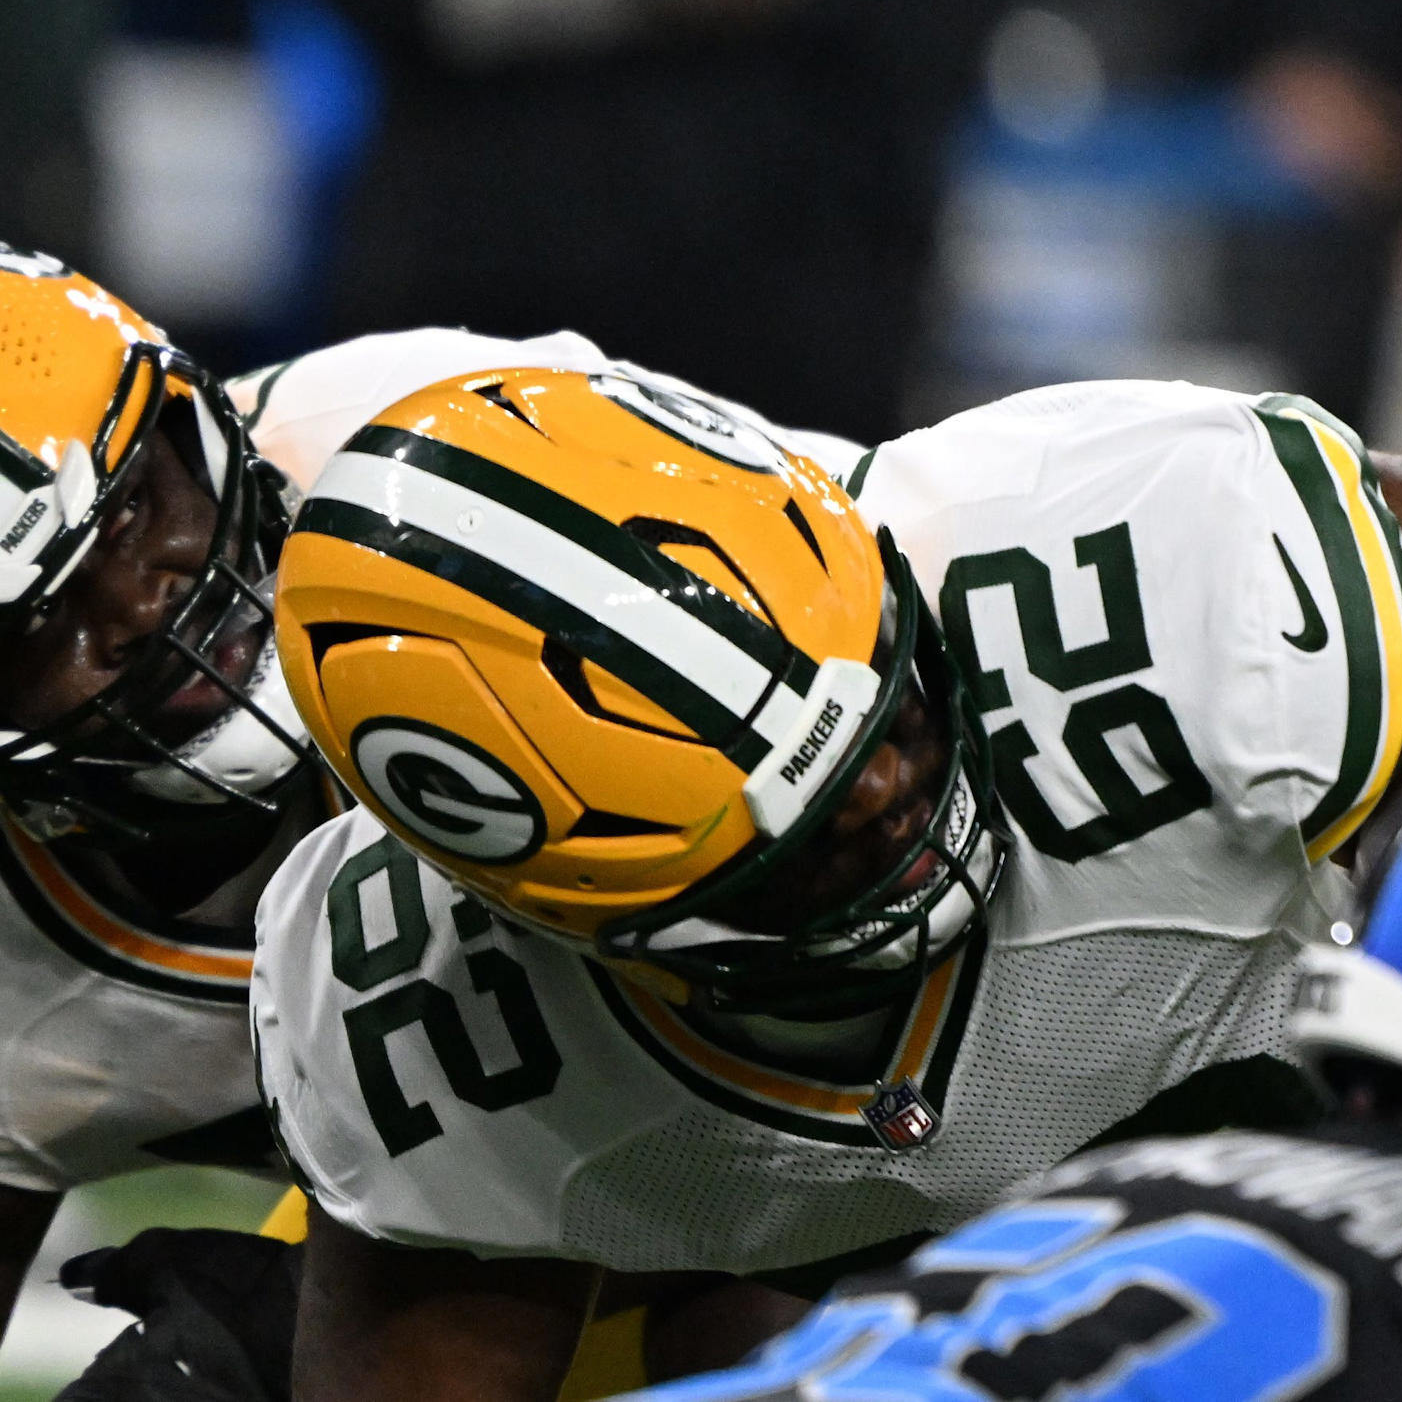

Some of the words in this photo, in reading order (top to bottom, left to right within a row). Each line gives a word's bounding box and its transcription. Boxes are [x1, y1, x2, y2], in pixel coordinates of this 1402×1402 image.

[0, 498, 48, 554] PACKERS
[780, 699, 843, 786] PACKERS
[939, 520, 1213, 864] 62
[354, 722, 542, 860] G
